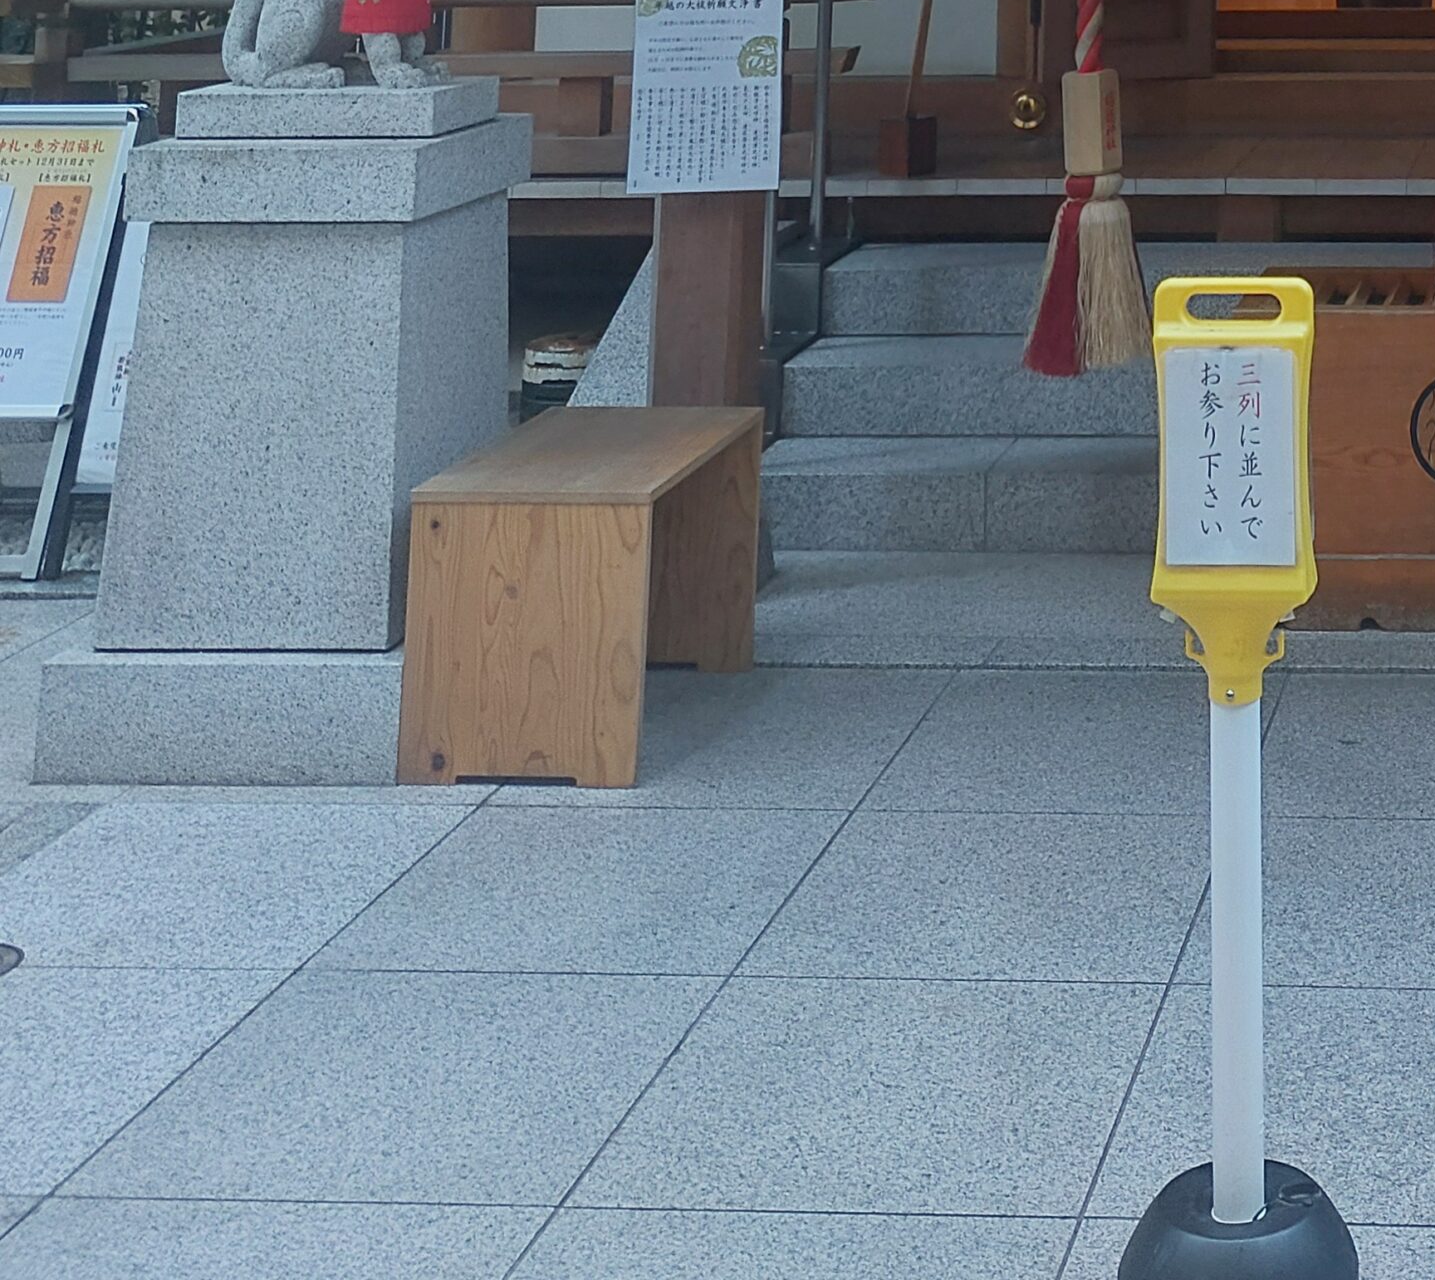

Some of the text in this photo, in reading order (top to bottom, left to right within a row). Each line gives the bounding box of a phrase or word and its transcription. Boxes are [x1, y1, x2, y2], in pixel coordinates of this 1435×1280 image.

[31, 201, 65, 286] 恵方招福
[1199, 361, 1224, 536] お参り下さい
[1236, 362, 1263, 540] 三列に並んで
